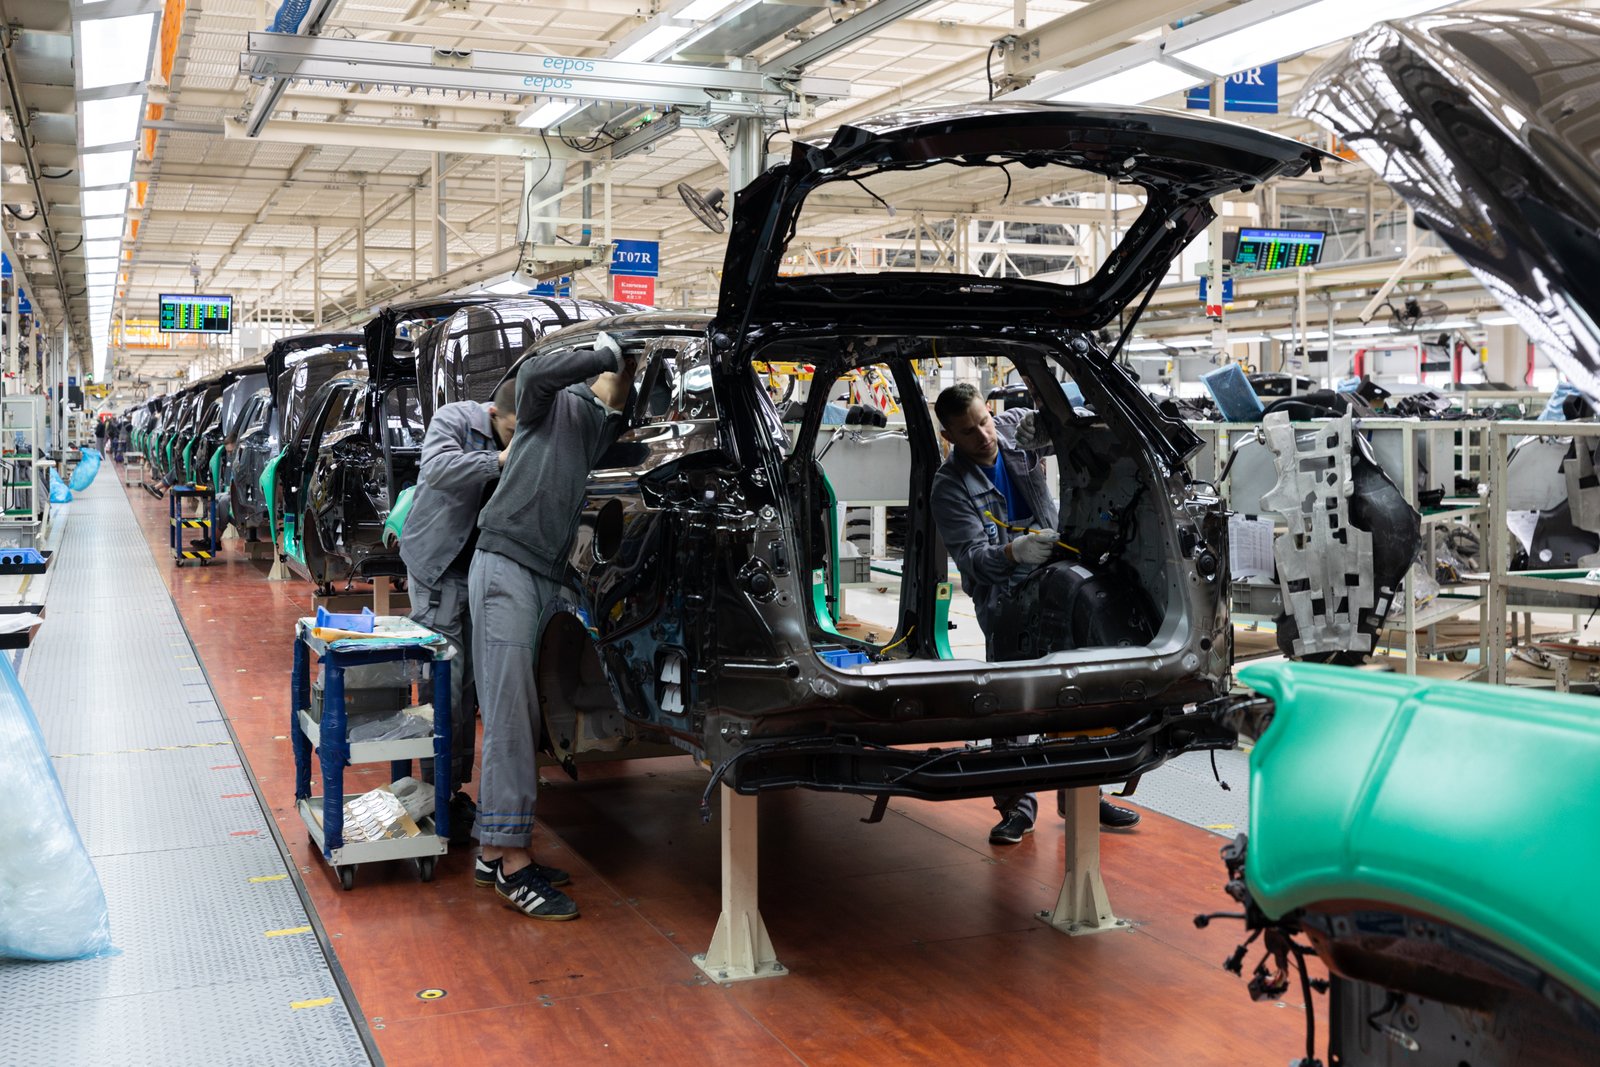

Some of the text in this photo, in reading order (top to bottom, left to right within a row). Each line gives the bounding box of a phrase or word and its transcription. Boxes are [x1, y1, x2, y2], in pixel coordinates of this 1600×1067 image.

[543, 57, 595, 75] eepos
[523, 75, 573, 92] eepos
[617, 251, 652, 263] T07R
